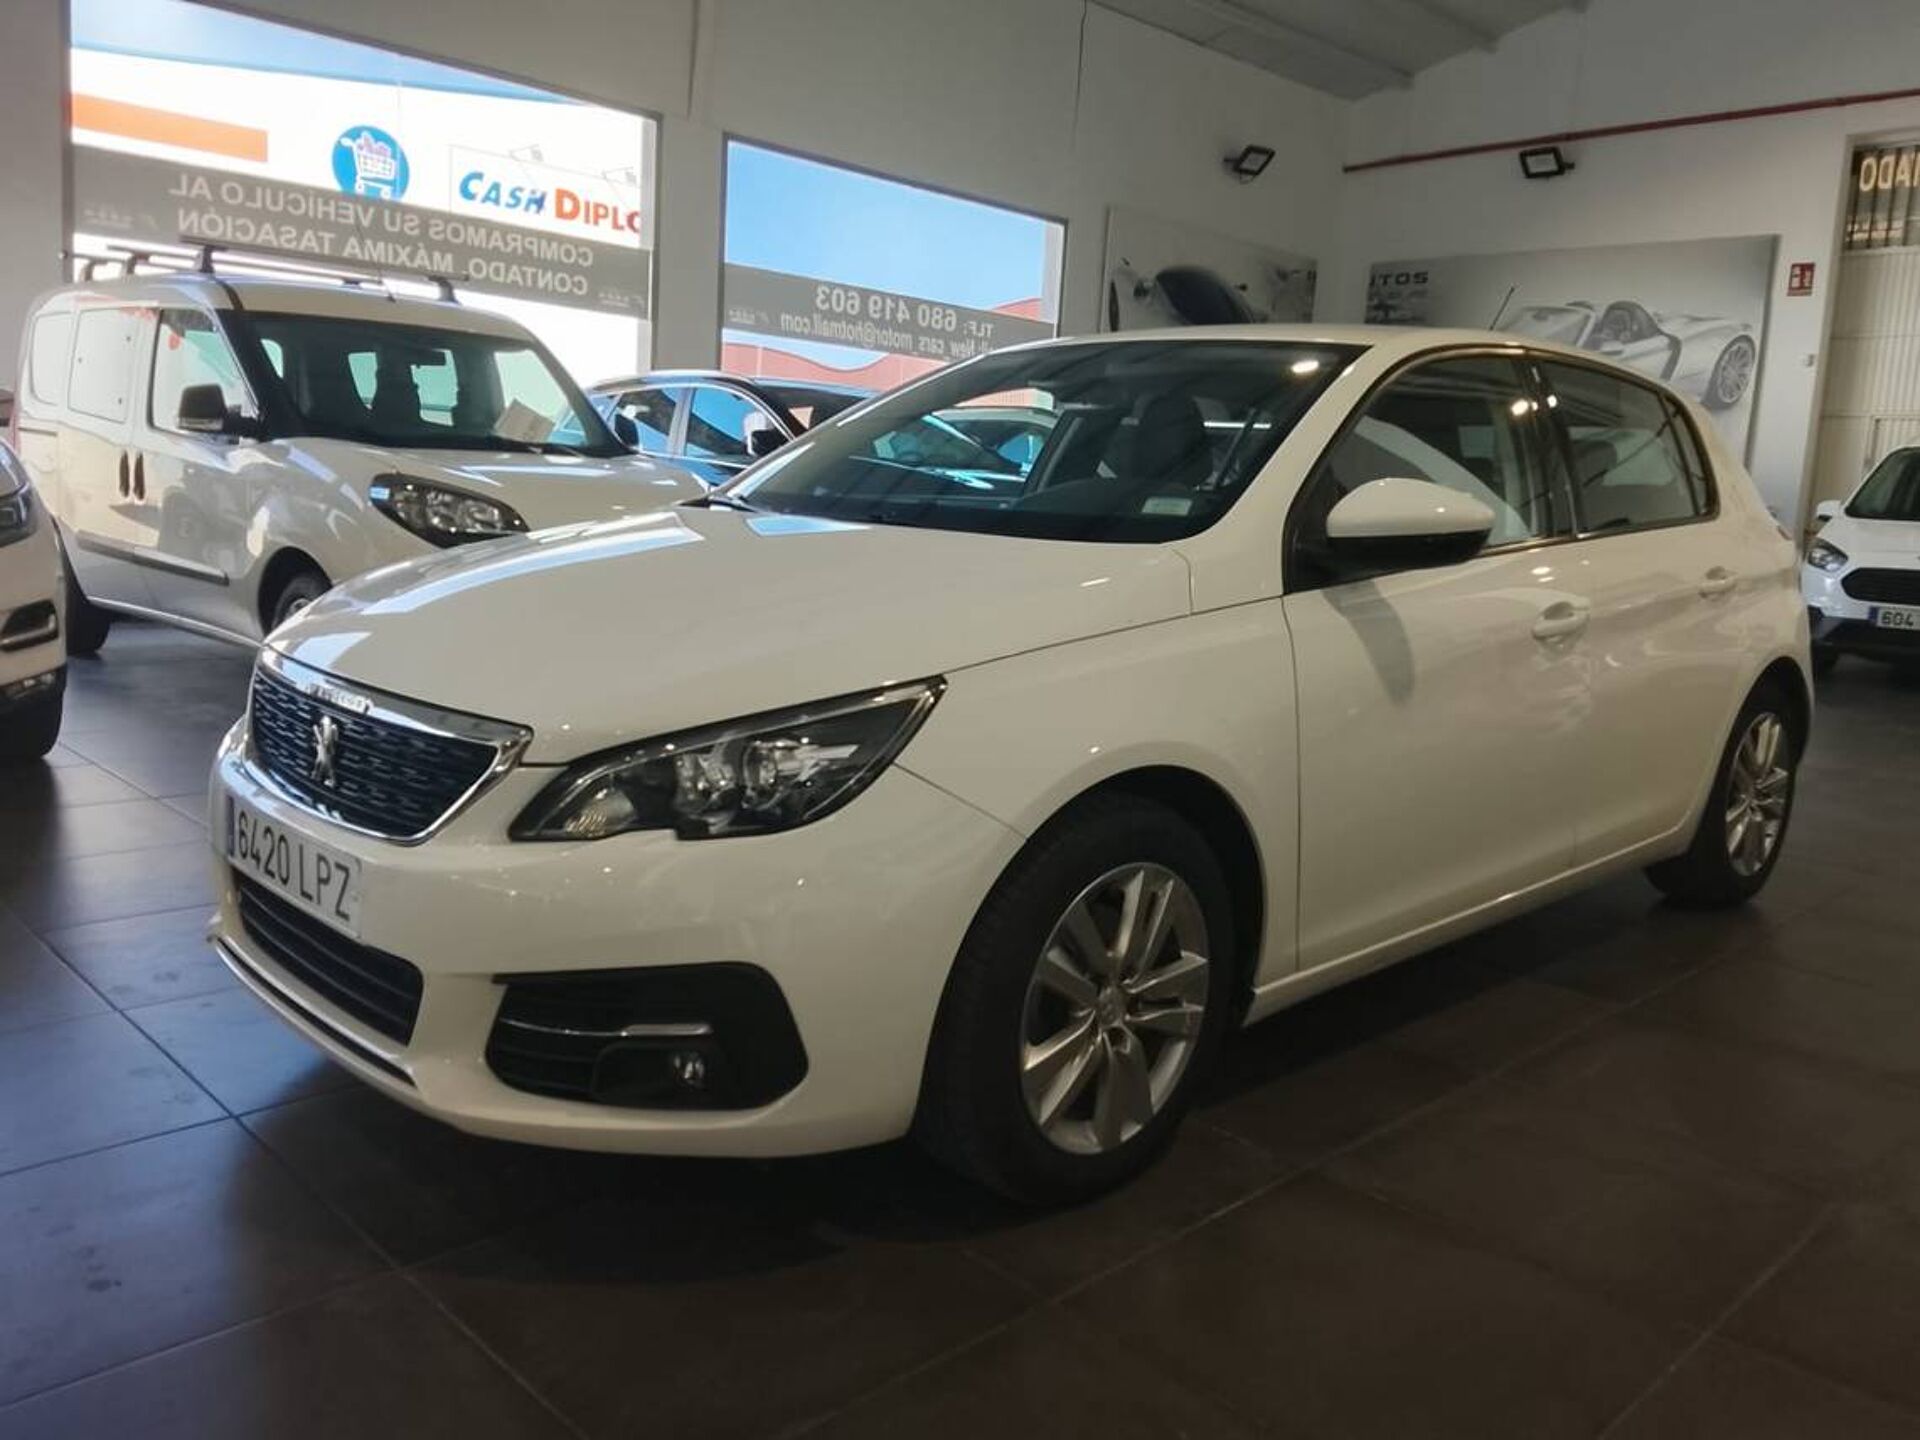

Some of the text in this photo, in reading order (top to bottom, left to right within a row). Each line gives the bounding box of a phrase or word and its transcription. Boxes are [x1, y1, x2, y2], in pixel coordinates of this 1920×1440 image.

[458, 171, 547, 215] CASH
[238, 810, 350, 921] 6420 LPZ
